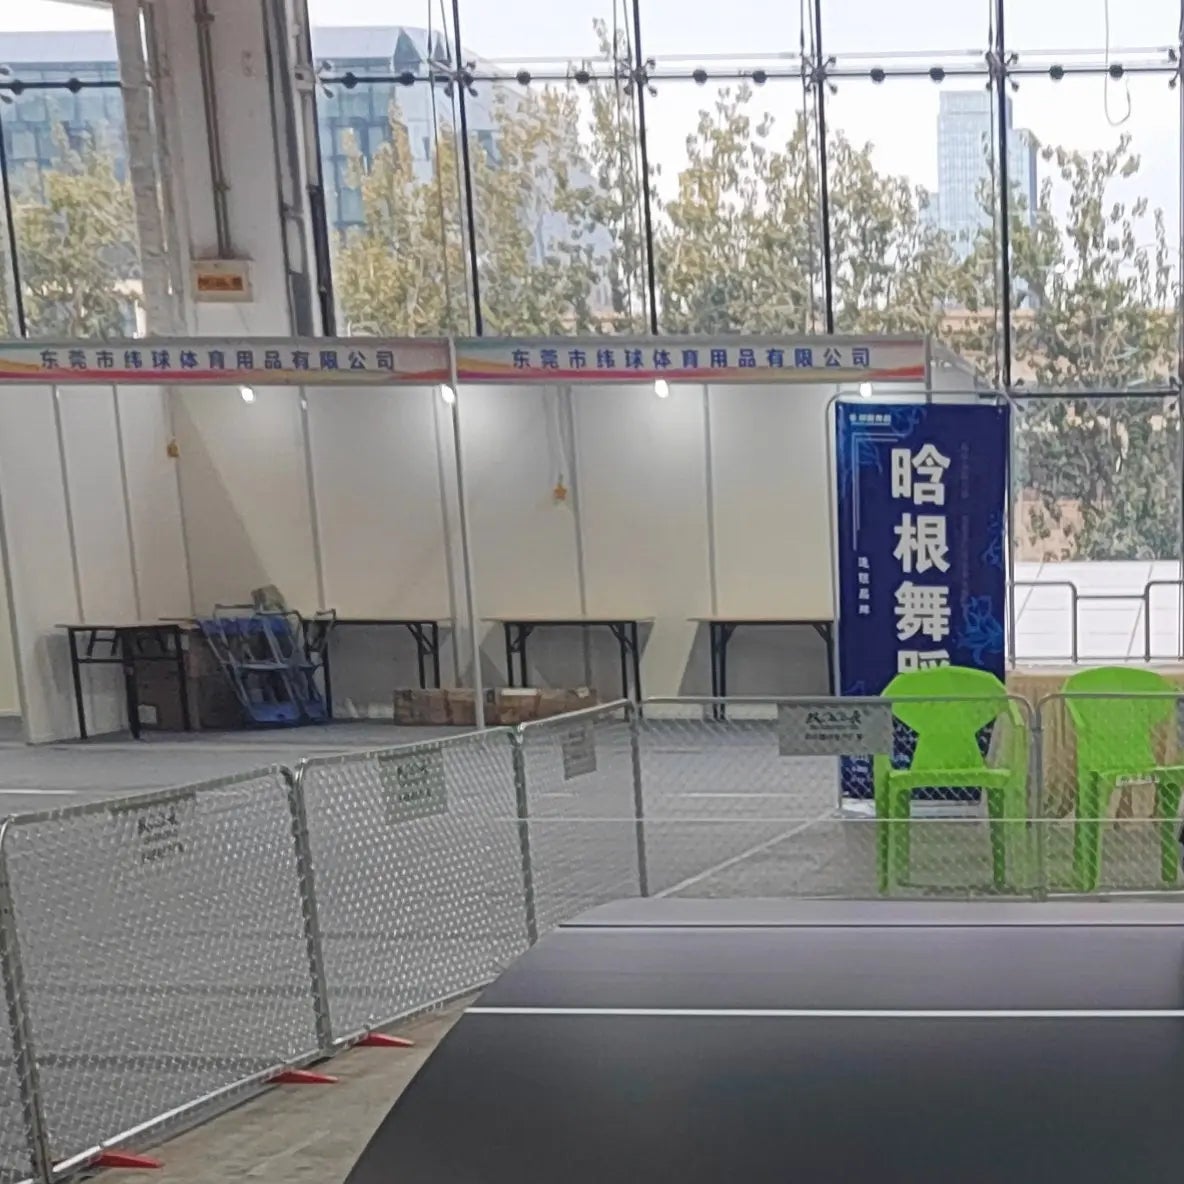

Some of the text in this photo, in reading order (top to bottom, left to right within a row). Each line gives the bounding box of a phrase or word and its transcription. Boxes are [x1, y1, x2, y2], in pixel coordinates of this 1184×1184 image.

[40, 349, 396, 370] 东莞市纬球体育用品有限公司
[511, 347, 872, 369] 东莞市纬球体育用品有限公司
